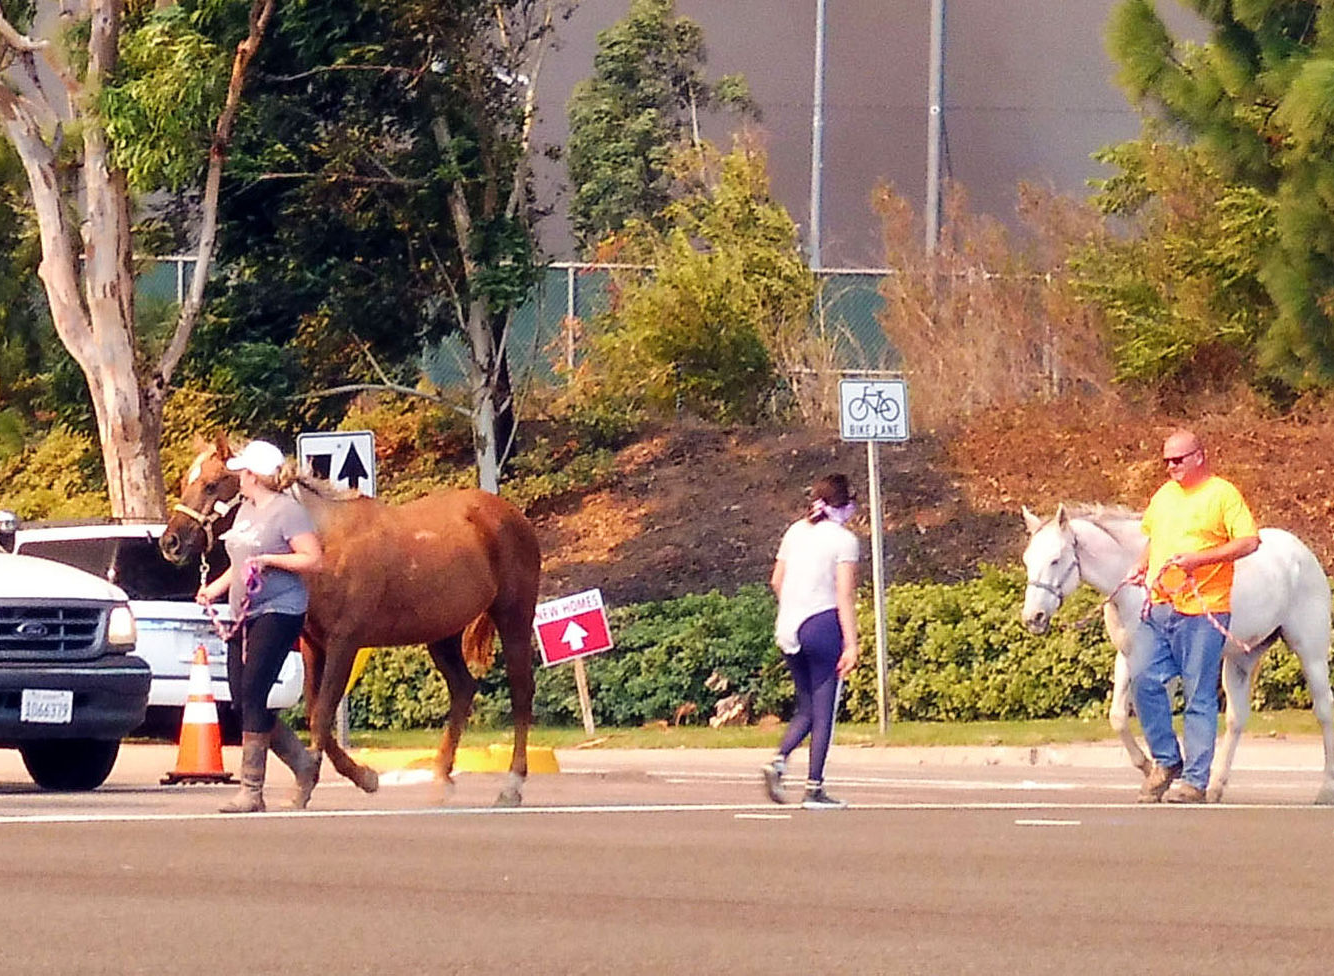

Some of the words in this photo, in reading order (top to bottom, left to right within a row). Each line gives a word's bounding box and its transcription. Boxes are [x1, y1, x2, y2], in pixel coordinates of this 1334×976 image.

[849, 424, 871, 436] BIKE
[874, 424, 899, 436] LANE
[536, 606, 559, 621] NEW
[563, 593, 599, 615] HOMES
